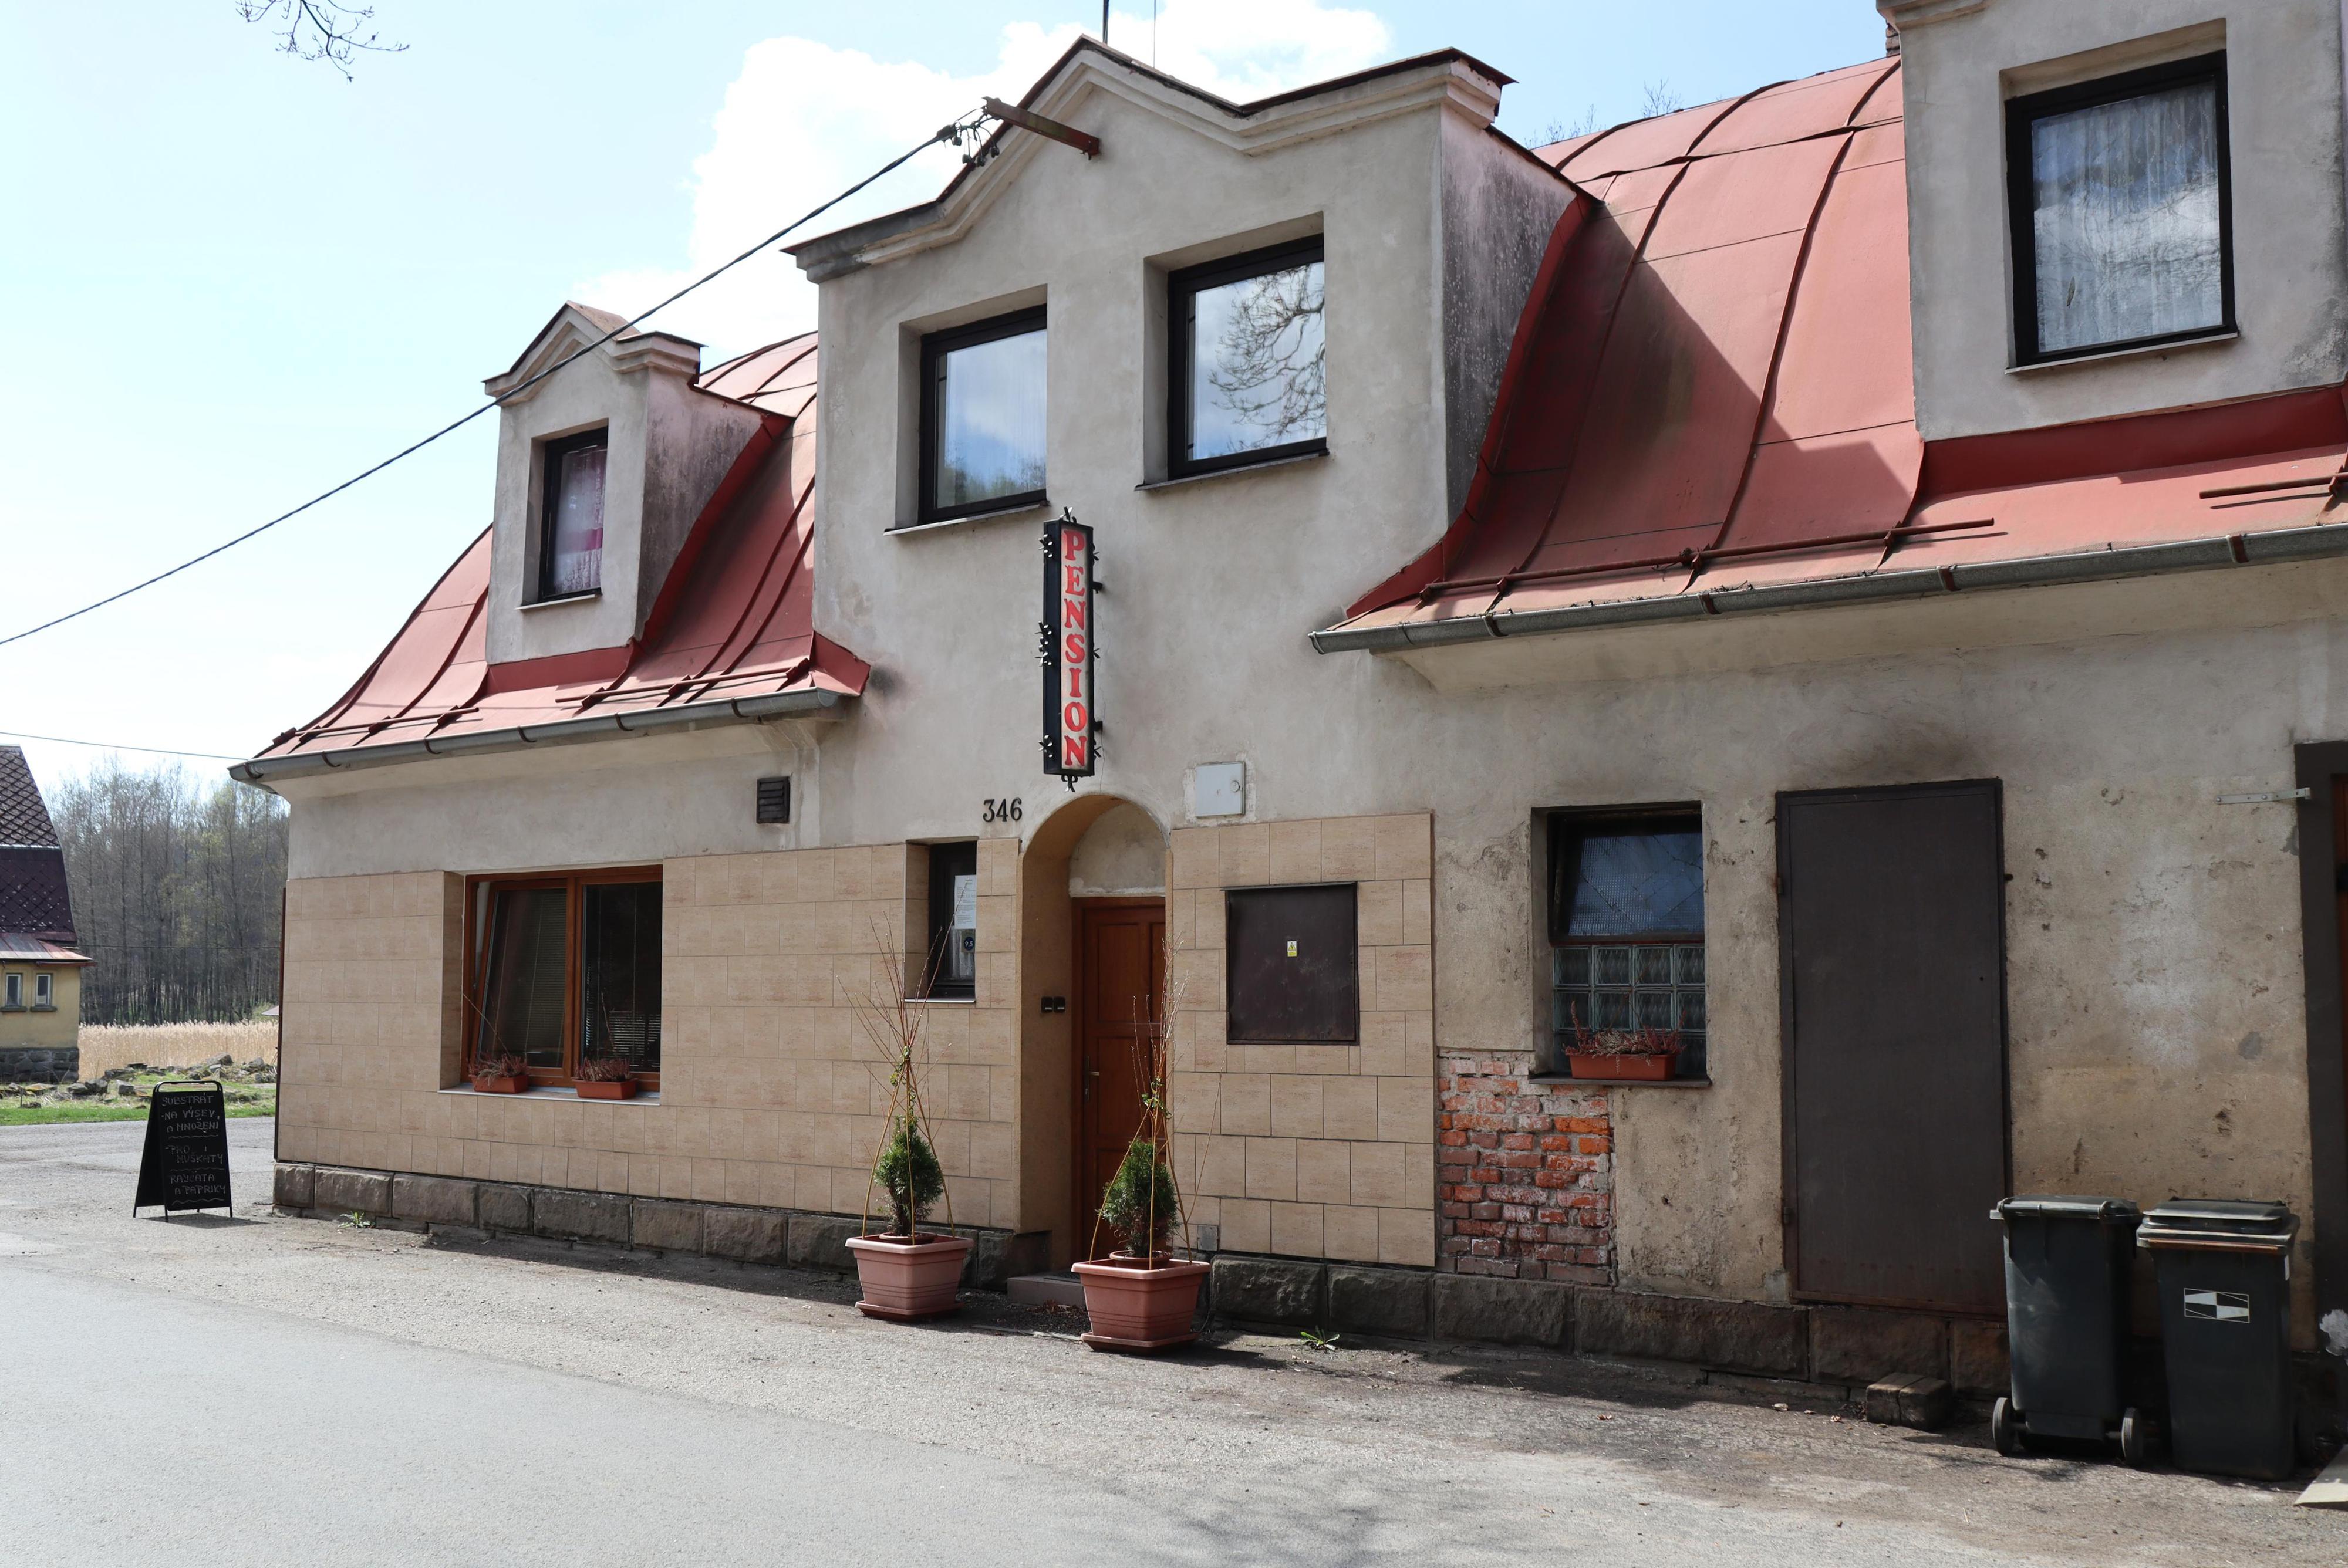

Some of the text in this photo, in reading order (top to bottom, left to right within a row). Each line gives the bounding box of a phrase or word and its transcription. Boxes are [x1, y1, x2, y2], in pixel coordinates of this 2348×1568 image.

[1064, 530, 1088, 766] PENSION
[983, 797, 1023, 822] 346
[161, 1092, 214, 1106] SUBSTRÁT
[175, 1185, 225, 1195] A PAPRIKY
